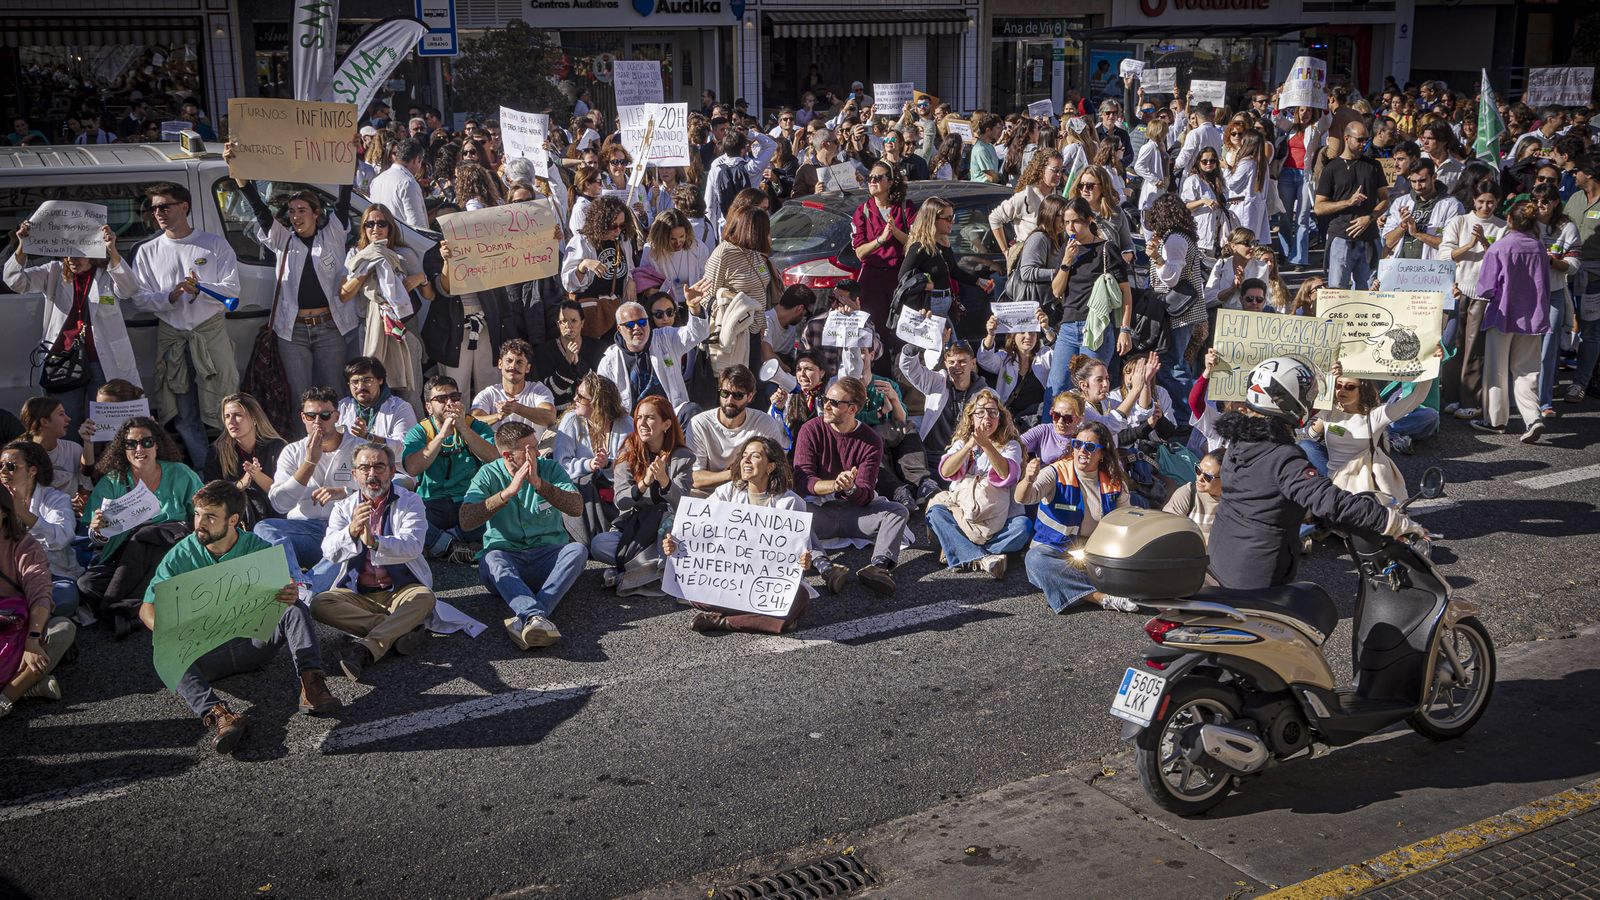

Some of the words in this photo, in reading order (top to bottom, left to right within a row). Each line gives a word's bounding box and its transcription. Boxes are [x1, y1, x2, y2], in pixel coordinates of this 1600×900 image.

[531, 0, 571, 9] Centros
[572, 0, 619, 9] Auditivos
[655, 0, 721, 14] Audika
[1004, 22, 1023, 34] Ana
[1025, 22, 1039, 34] de
[234, 103, 289, 120] TURNOS
[658, 106, 684, 130] 20H
[624, 129, 684, 143] TRAJANDO
[450, 217, 505, 241] LLEVO
[451, 247, 472, 258] SIN
[476, 242, 516, 256] DORMIR
[1328, 312, 1349, 320] CREO
[1355, 312, 1369, 320] QUE
[1371, 312, 1381, 320] DE
[1221, 313, 1250, 339] MI
[1256, 315, 1343, 349] VOCACIÓN
[686, 502, 711, 518] LA
[728, 509, 805, 533] SANIDAD
[682, 520, 748, 544] PÚBLICA
[759, 533, 787, 548] NO
[678, 540, 726, 554] CUIDA
[735, 545, 754, 559] DE
[760, 565, 769, 577] A
[776, 566, 800, 580] SUS
[674, 571, 743, 598] MÉDICOS!
[755, 580, 792, 596] STOP
[1132, 674, 1162, 696] 5605
[1124, 691, 1149, 712] LKK
